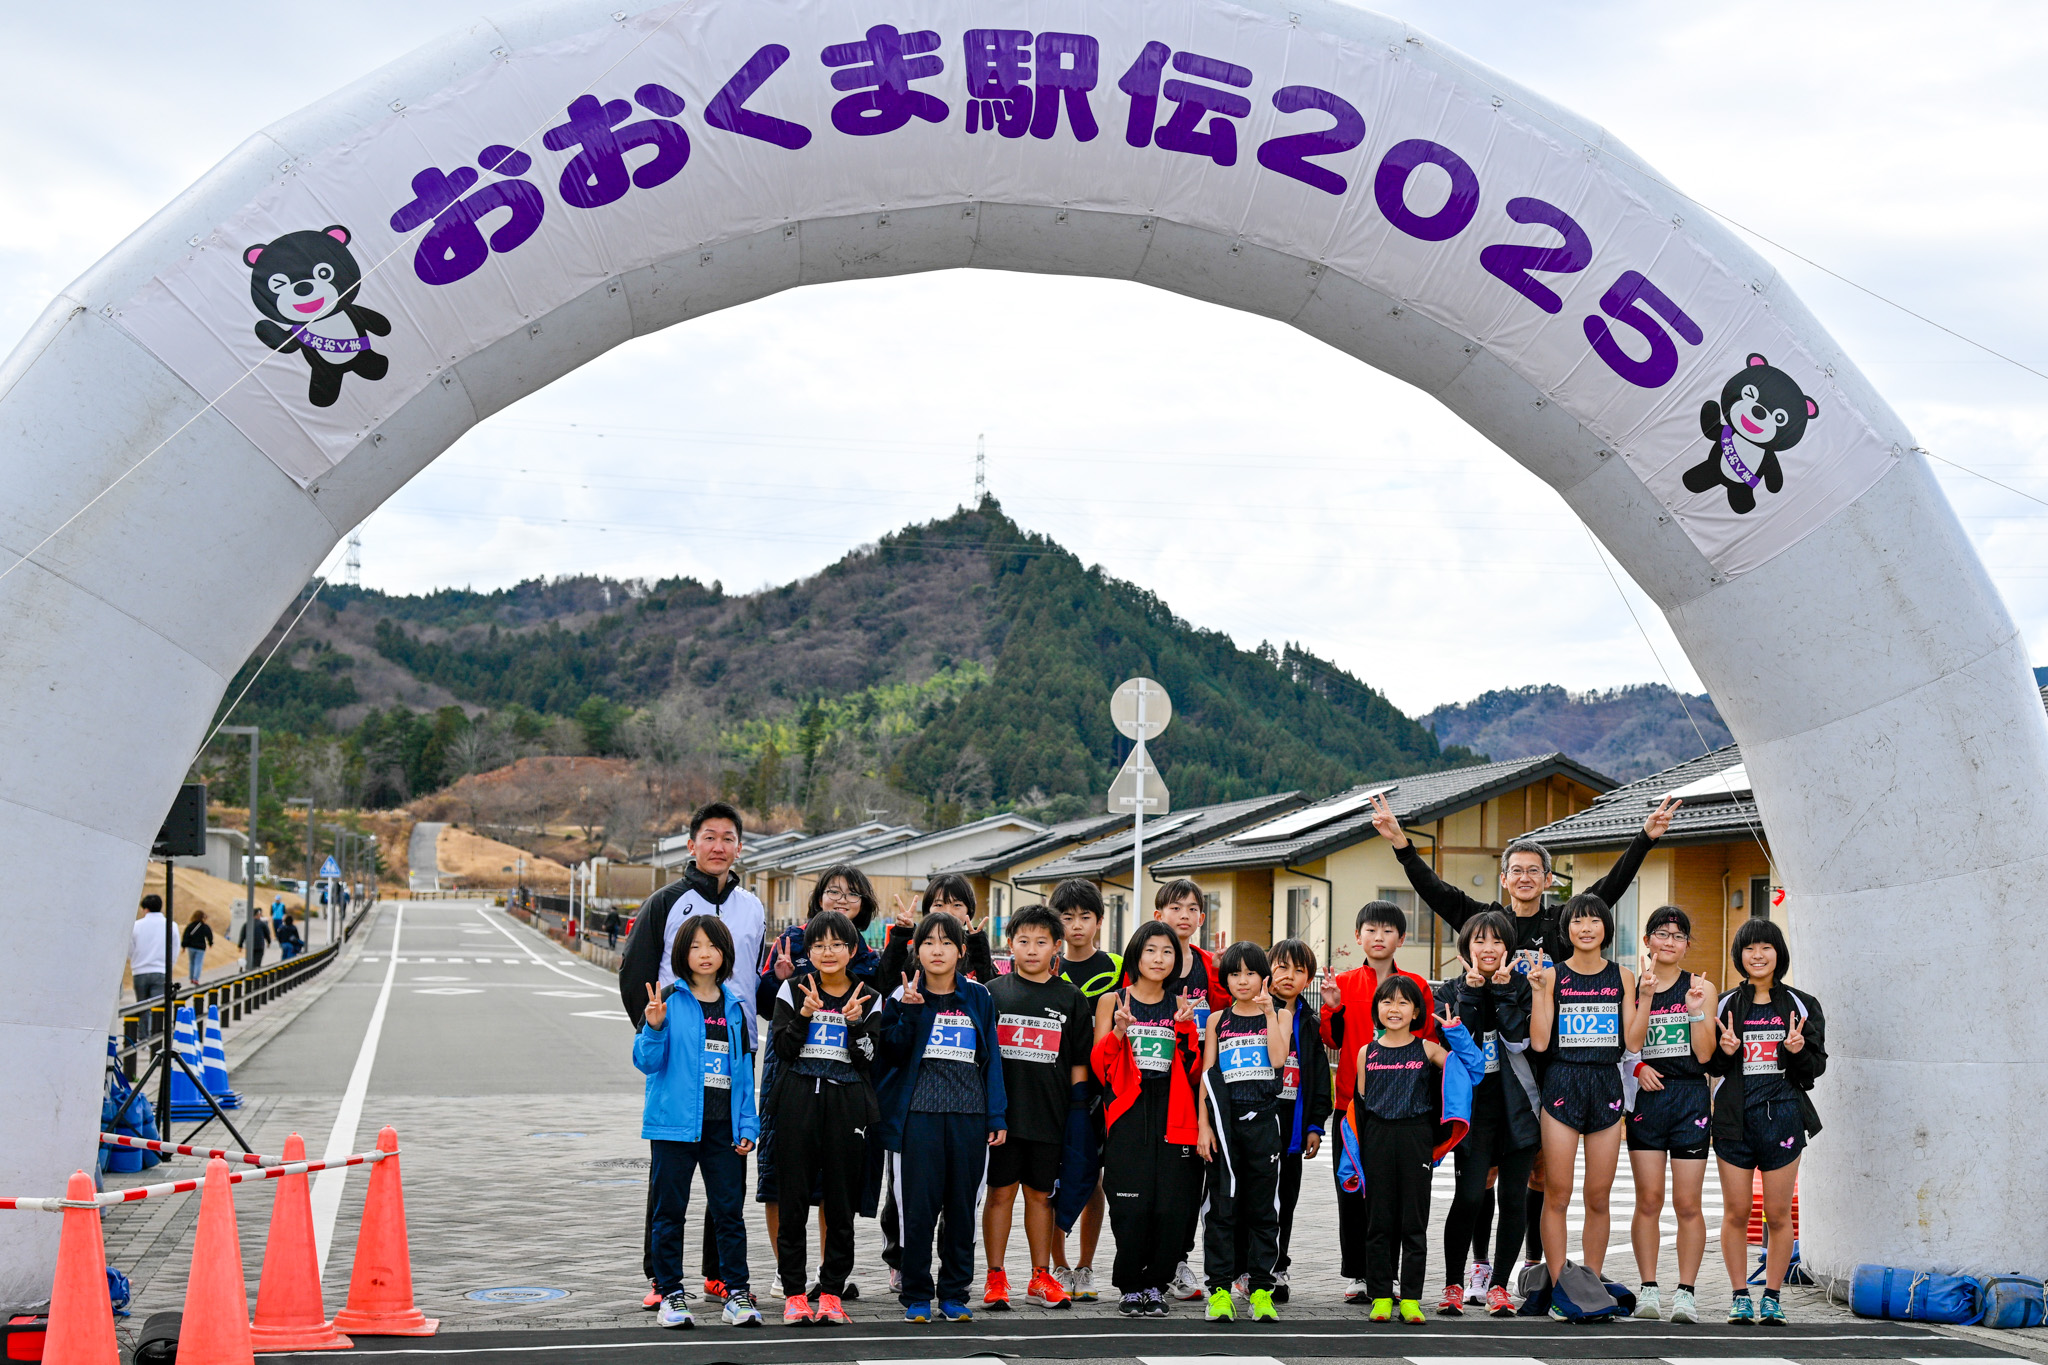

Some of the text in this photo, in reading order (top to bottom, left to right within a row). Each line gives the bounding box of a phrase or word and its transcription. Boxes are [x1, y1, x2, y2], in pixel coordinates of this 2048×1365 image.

[311, 335, 361, 352] おおくま
[1723, 444, 1753, 482] おおくま
[1560, 988, 1599, 997] Watanabe
[1561, 1005, 1617, 1013] おおくま駅伝 2025
[1001, 1017, 1060, 1030] おおくま駅伝 2025
[1563, 1014, 1615, 1034] 102-3
[1670, 1015, 1687, 1023] 2025
[814, 1024, 845, 1047] 4-1
[931, 1026, 962, 1047] 5-1
[1011, 1027, 1044, 1049] 4-4
[1220, 1038, 1255, 1051] おおくま駅伝
[1644, 1025, 1686, 1047] 02-2
[1132, 1037, 1162, 1058] 4-2
[1230, 1048, 1262, 1067] 4-3
[1366, 1061, 1404, 1071] Watanabe
